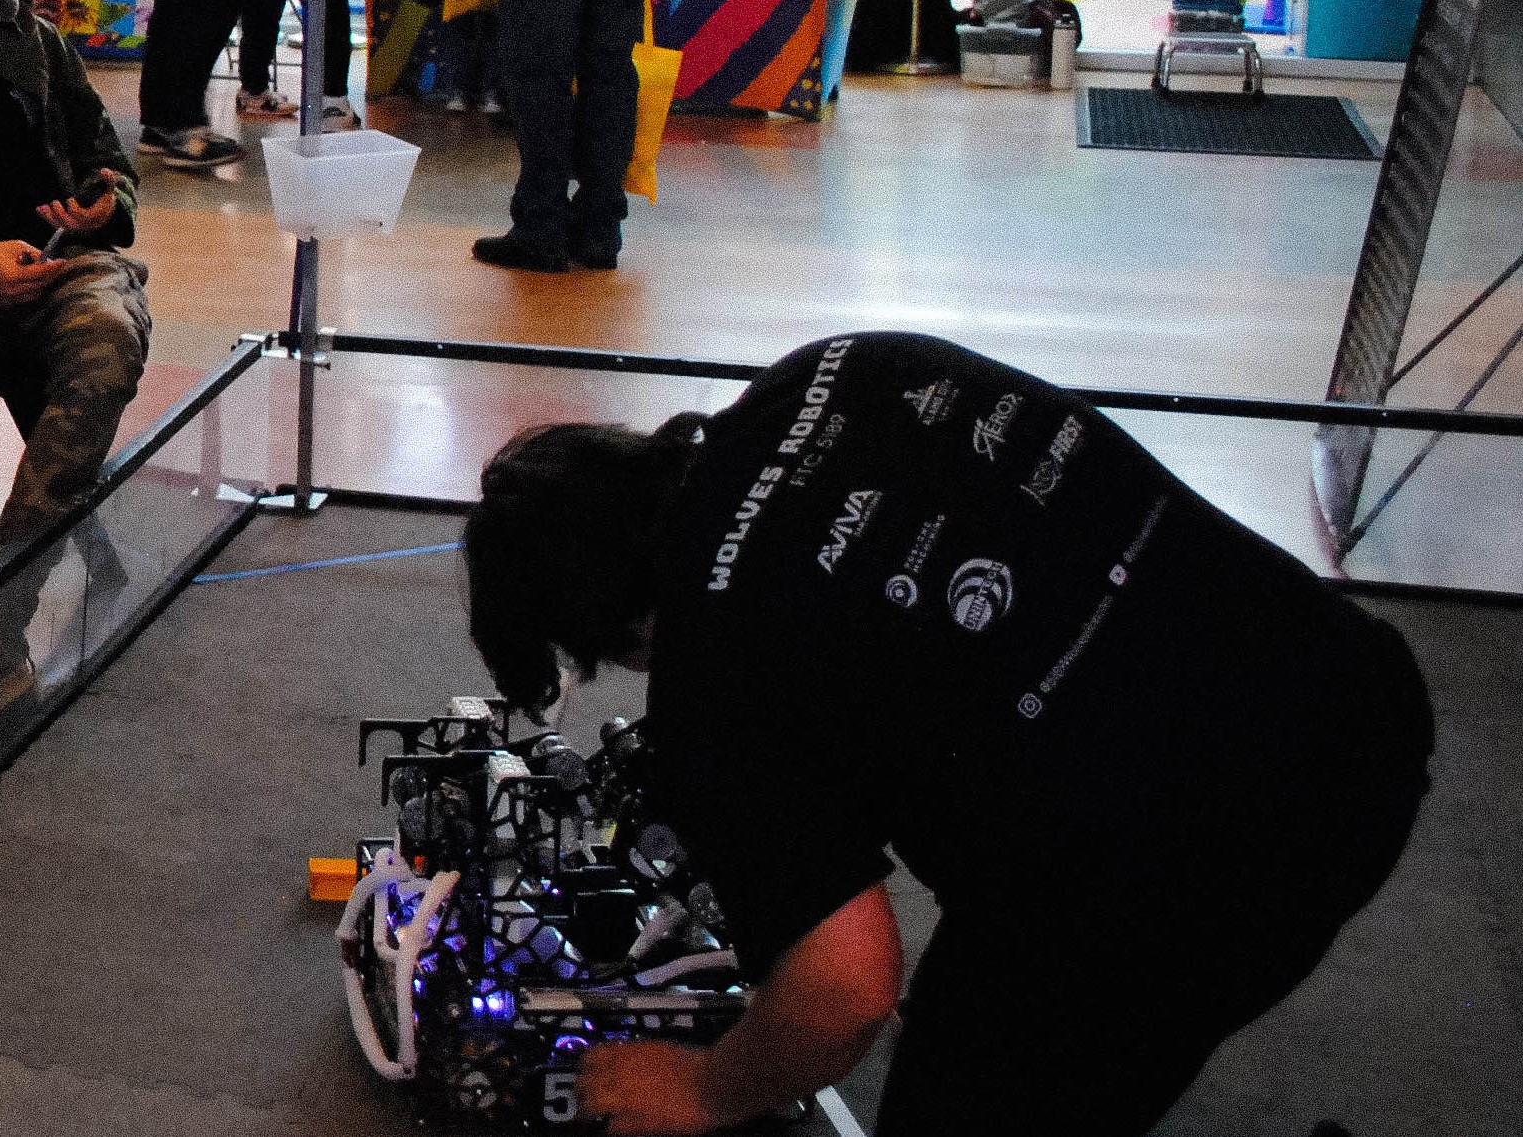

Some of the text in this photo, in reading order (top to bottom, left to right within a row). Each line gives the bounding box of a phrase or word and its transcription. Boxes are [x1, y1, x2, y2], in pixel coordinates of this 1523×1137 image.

[706, 338, 854, 592] WOLVES ROBOTICS
[789, 412, 845, 487] FTC 5189
[1048, 415, 1084, 463] FIRST
[817, 489, 874, 572] AVIVA
[961, 560, 1006, 630] UNINTECH
[542, 1071, 578, 1123] 5
